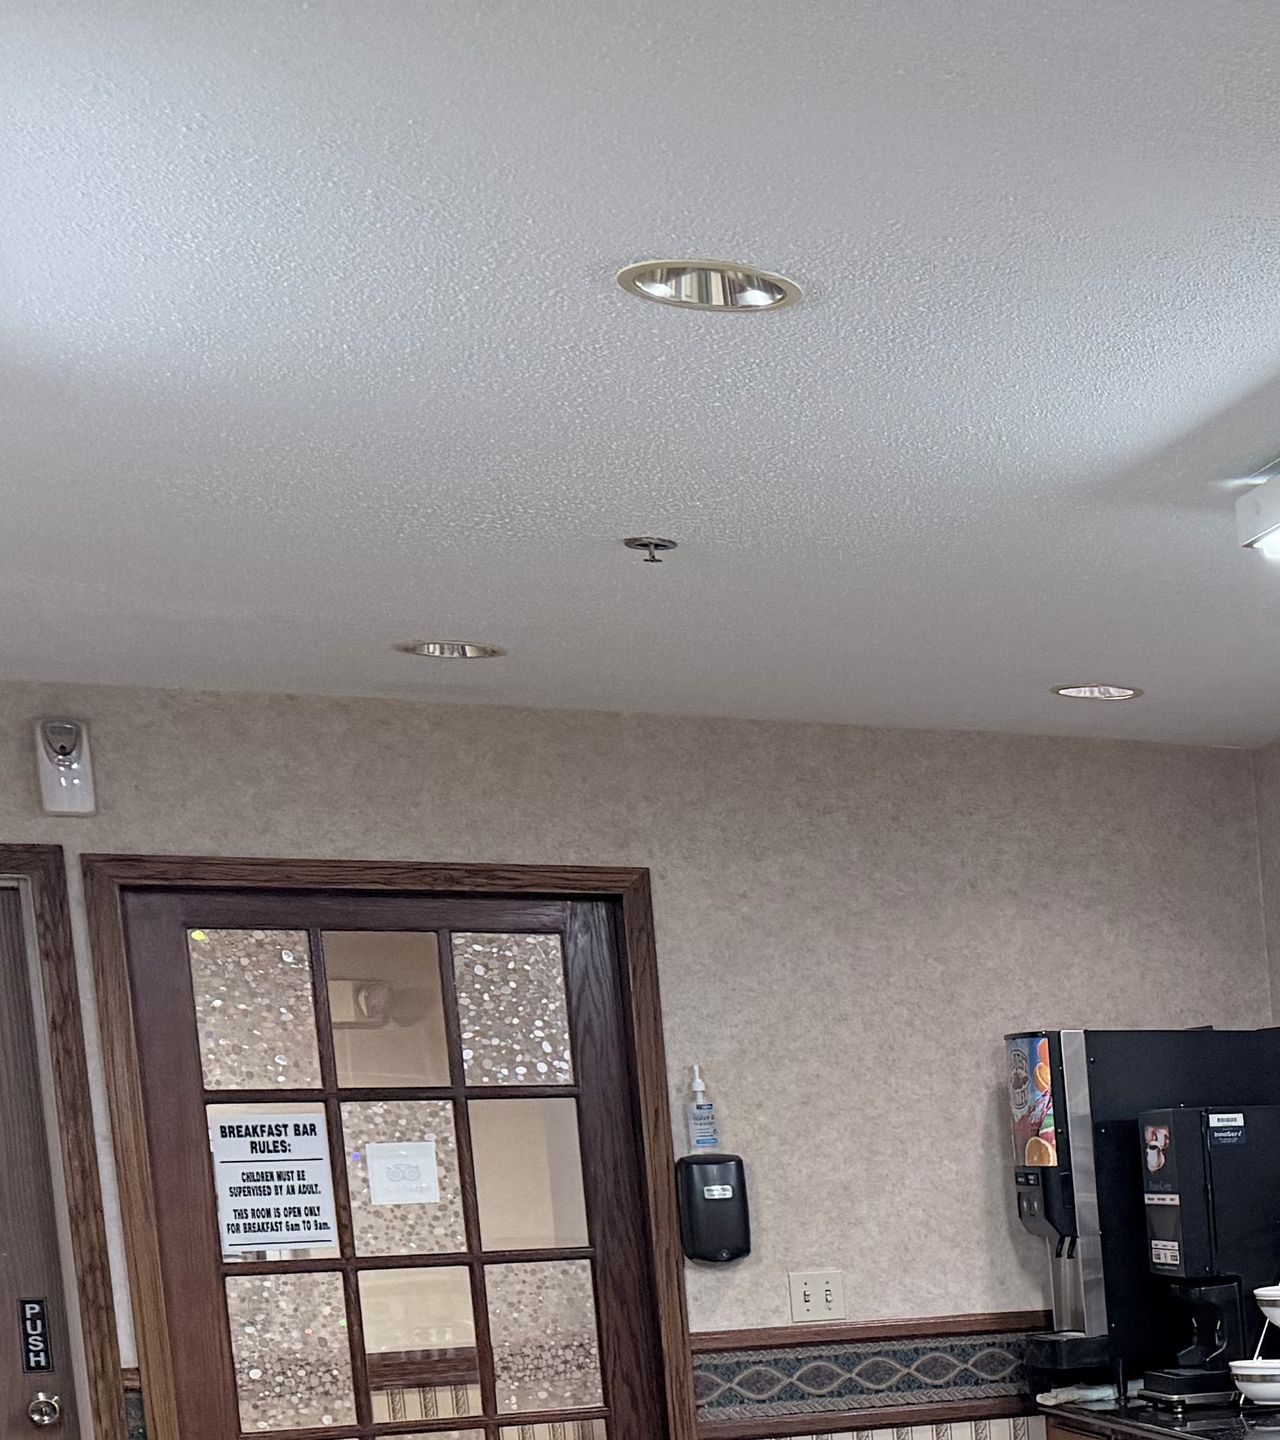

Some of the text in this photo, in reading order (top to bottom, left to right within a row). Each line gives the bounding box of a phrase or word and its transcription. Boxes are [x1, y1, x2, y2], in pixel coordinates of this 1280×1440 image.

[219, 1123, 317, 1138] BREAKFAST BAR
[250, 1139, 292, 1154] RULES:
[241, 1169, 306, 1183] CHILDREN MUST BE
[228, 1183, 321, 1197] SUPERVISED BY AN ADULT.
[233, 1205, 320, 1220] THIS ROOM IS OPEN ONLY
[226, 1223, 241, 1235] FOR
[243, 1221, 283, 1233] BREAKFAST
[285, 1220, 301, 1232] 6am
[302, 1219, 312, 1231] TO
[25, 1304, 46, 1367] PUSH
